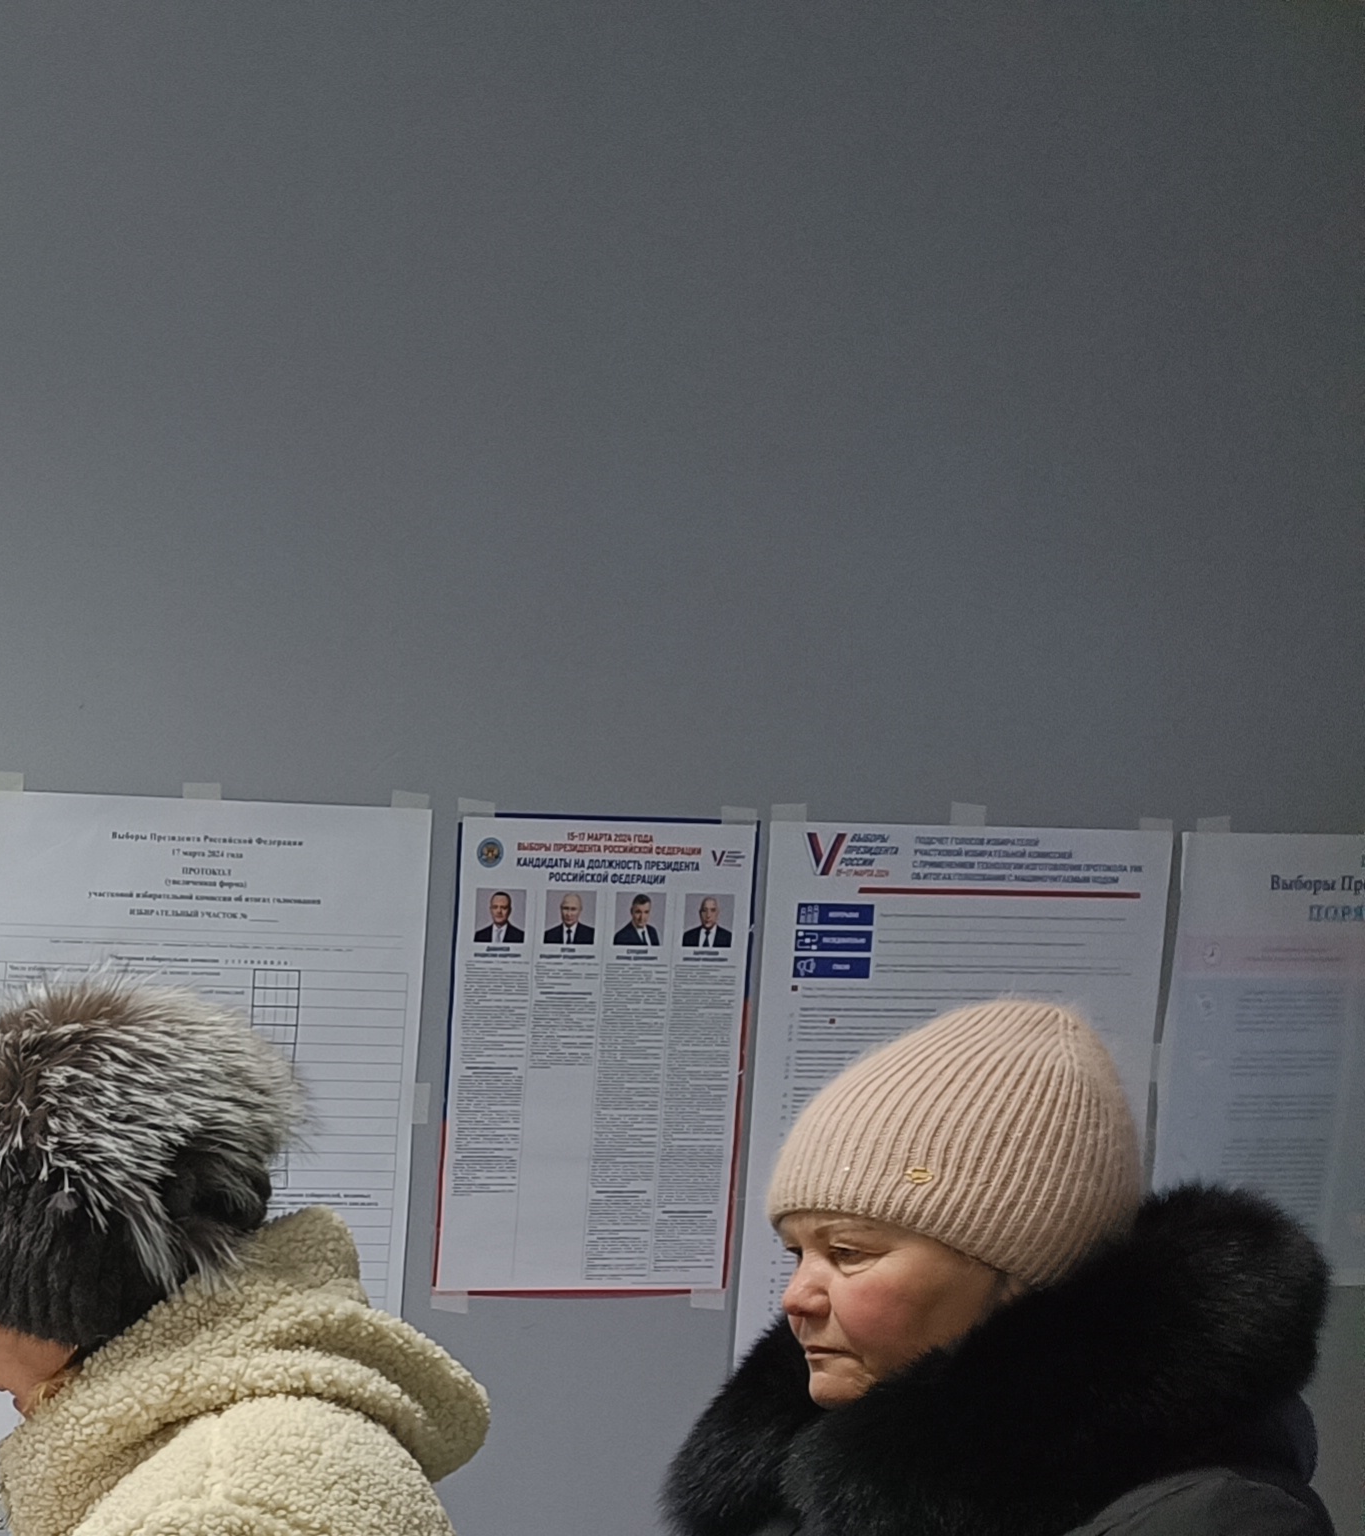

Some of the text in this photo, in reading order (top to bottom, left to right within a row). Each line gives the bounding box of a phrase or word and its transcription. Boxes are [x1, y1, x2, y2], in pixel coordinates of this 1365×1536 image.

[111, 831, 147, 842] Выборы
[203, 835, 253, 845] Российской
[587, 833, 612, 842] МАРТА
[614, 833, 632, 843] 2024
[633, 834, 653, 844] ГОДА
[850, 833, 890, 843] ВЫБОРЫ
[517, 842, 701, 856] ВЫБОРЫ ПРЕЗИДЕНТА РОССИЙСКОЙ ФЕДЕРАЦИИ
[844, 845, 899, 856] ПРЕЗИДЕНТА
[516, 857, 700, 872] КАНДИДАТЫ НА ДОЛЖНОСТЬ ПРЕЗИДЕНТА
[839, 857, 876, 867] РОССИИ
[182, 867, 232, 876] ПРОТОКОЛ
[548, 870, 666, 885] РОССИЙСКОЙ ФЕДЕРАЦИИ
[1270, 874, 1365, 895] Выборы Пр
[200, 911, 238, 919] УЧАСТОК
